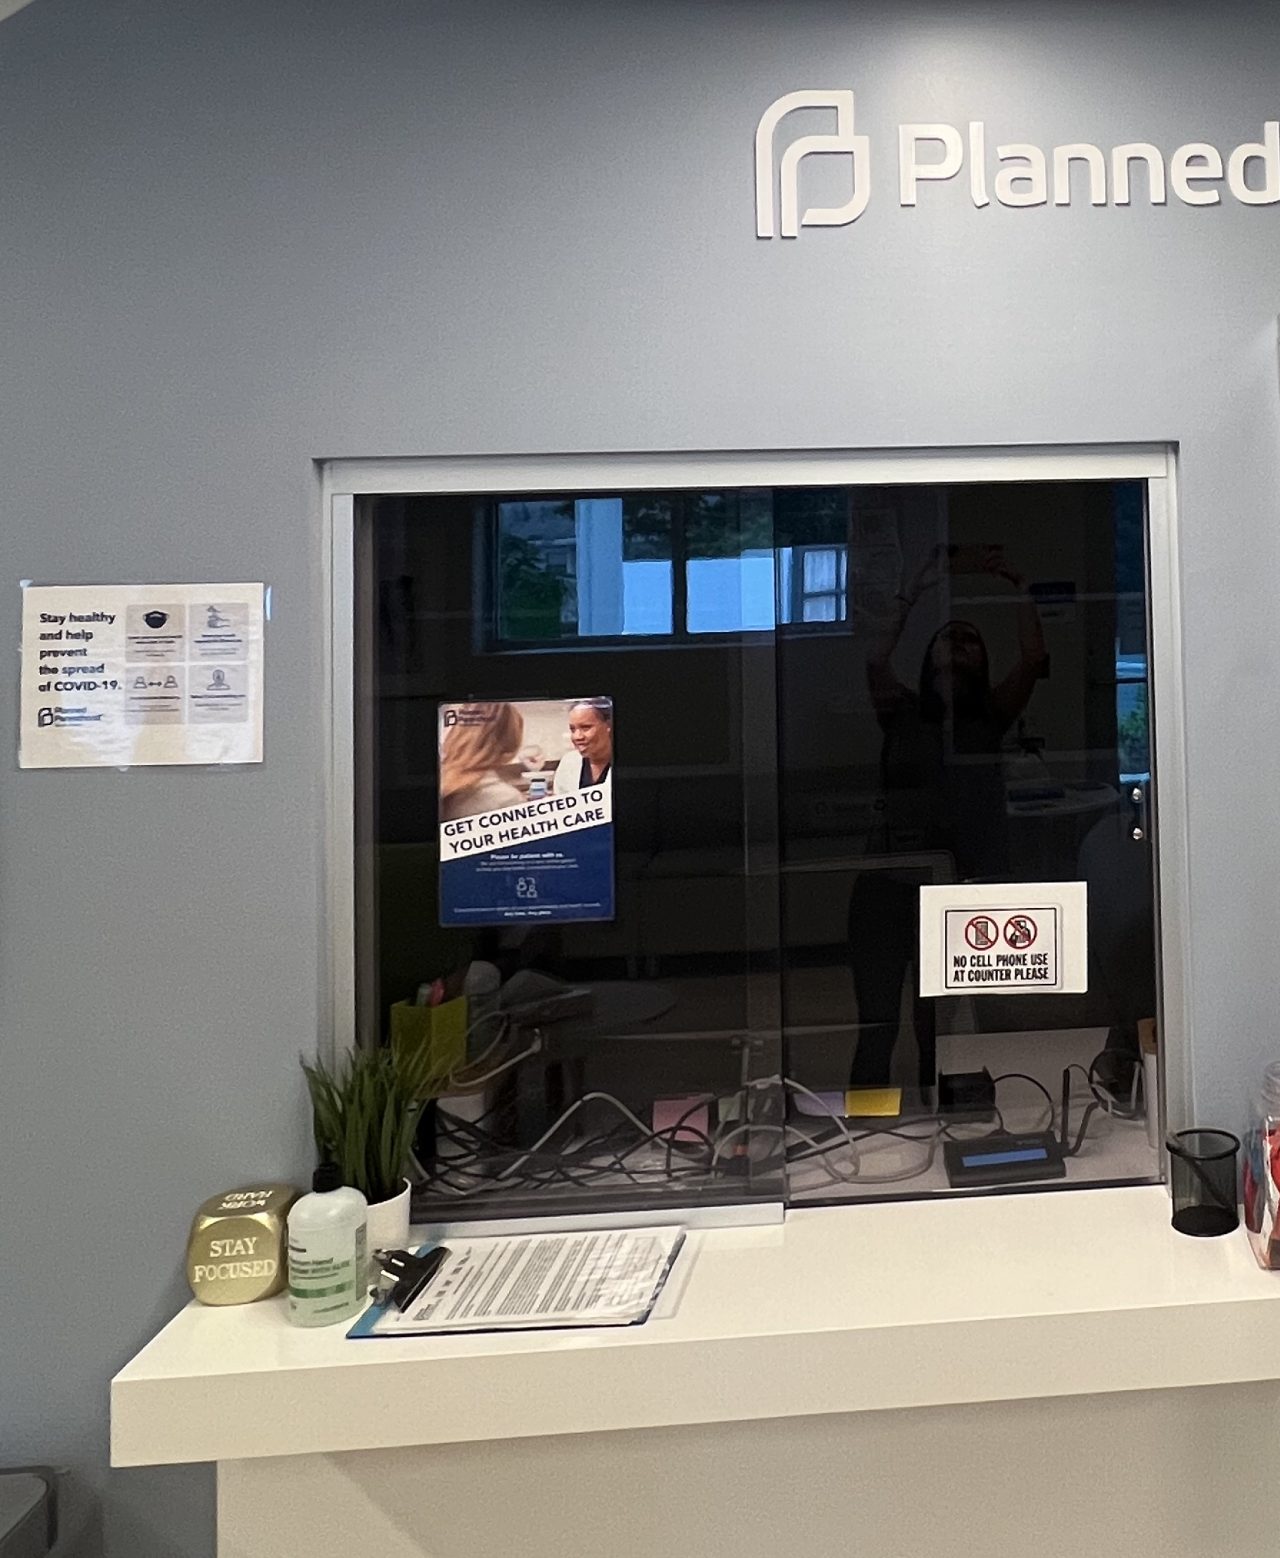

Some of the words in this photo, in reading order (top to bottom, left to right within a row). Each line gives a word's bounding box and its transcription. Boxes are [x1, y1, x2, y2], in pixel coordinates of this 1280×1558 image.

[40, 613, 66, 626] Stay
[69, 612, 116, 625] healthy
[39, 631, 62, 641] and
[65, 629, 94, 643] help
[39, 647, 88, 660] prevent
[39, 664, 59, 675] the
[61, 663, 105, 676] spread
[38, 681, 51, 692] of
[54, 680, 122, 692] COVID-19.
[444, 819, 474, 837] GET
[479, 796, 577, 829] CONNECTED
[581, 790, 603, 805] TO
[449, 833, 494, 854] YOUR
[499, 818, 558, 844] HEALTH
[562, 807, 605, 828] CARE
[953, 955, 967, 968] NO
[970, 954, 992, 967] CELL
[996, 953, 1028, 967] PHONE
[1031, 953, 1048, 966] USE
[953, 970, 965, 982] AT
[968, 968, 1011, 982] COUNTER
[1014, 967, 1049, 980] PLEASE
[210, 1237, 257, 1257] STAY
[193, 1259, 277, 1283] FOCUSED
